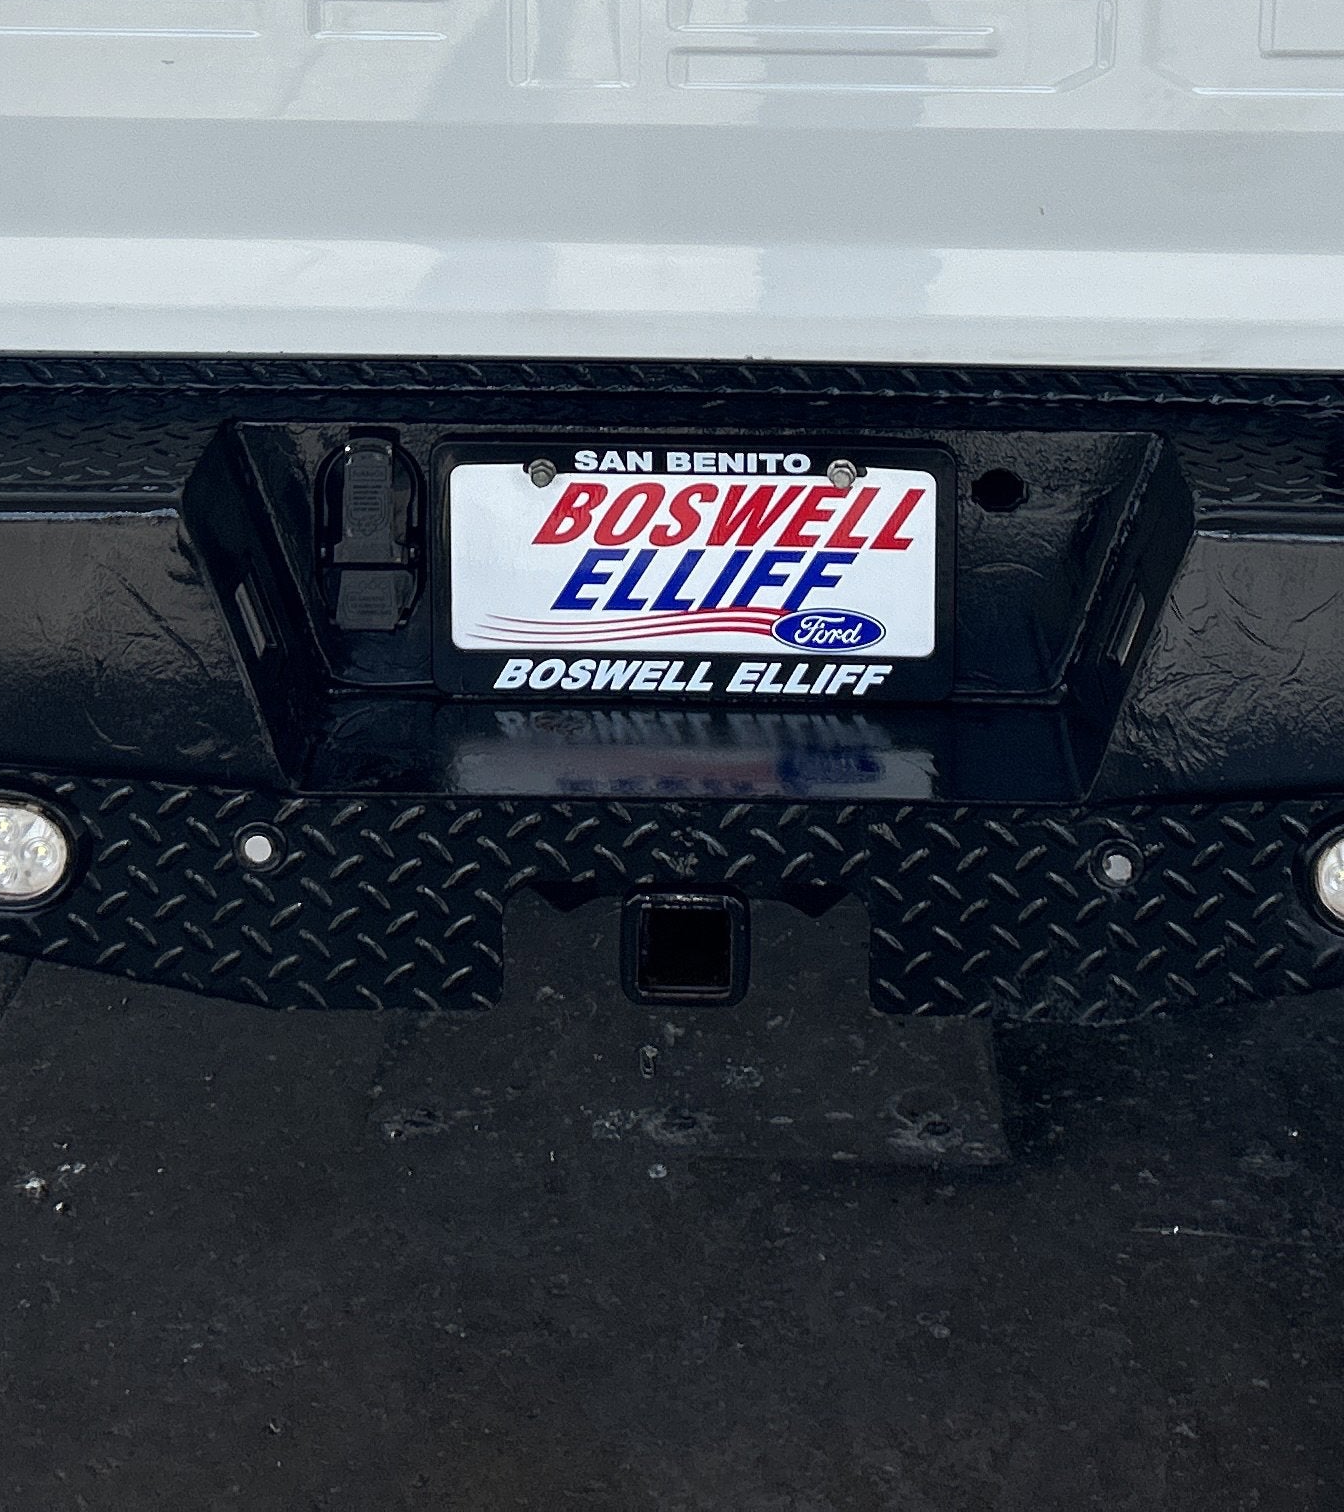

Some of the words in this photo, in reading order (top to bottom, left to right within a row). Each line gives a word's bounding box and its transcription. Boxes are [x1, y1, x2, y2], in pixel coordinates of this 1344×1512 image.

[573, 449, 653, 473] SAN
[666, 451, 811, 474] BENITO
[531, 482, 927, 551] BOSWELL
[550, 548, 860, 612] ELLIFF
[793, 614, 864, 646] Ford
[493, 658, 715, 692] BOSWELL
[726, 662, 893, 696] ELLIFF
